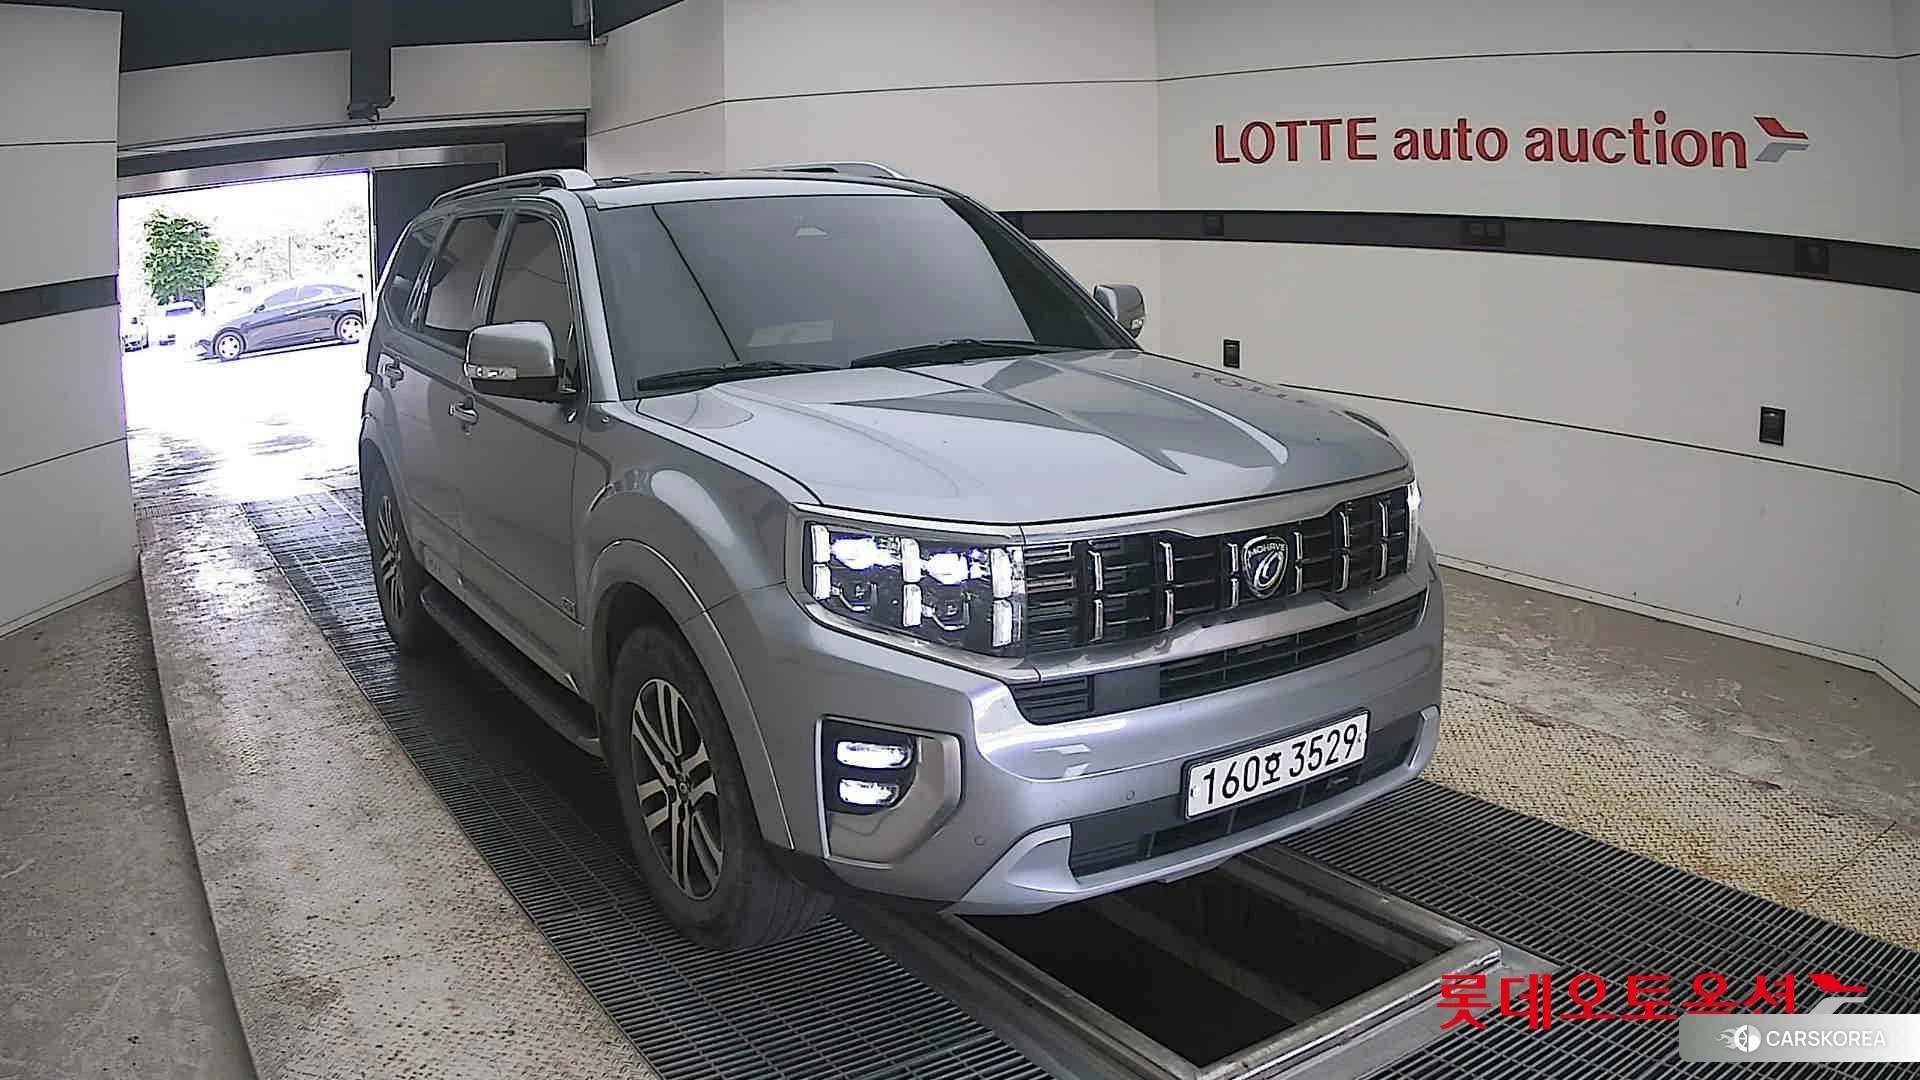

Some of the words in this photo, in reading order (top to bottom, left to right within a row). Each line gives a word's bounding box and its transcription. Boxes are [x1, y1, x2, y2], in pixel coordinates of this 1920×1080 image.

[1214, 117, 1378, 164] LOTTE
[1393, 118, 1509, 162] auto
[1525, 111, 1748, 169] auction
[1289, 724, 1358, 778] 3529
